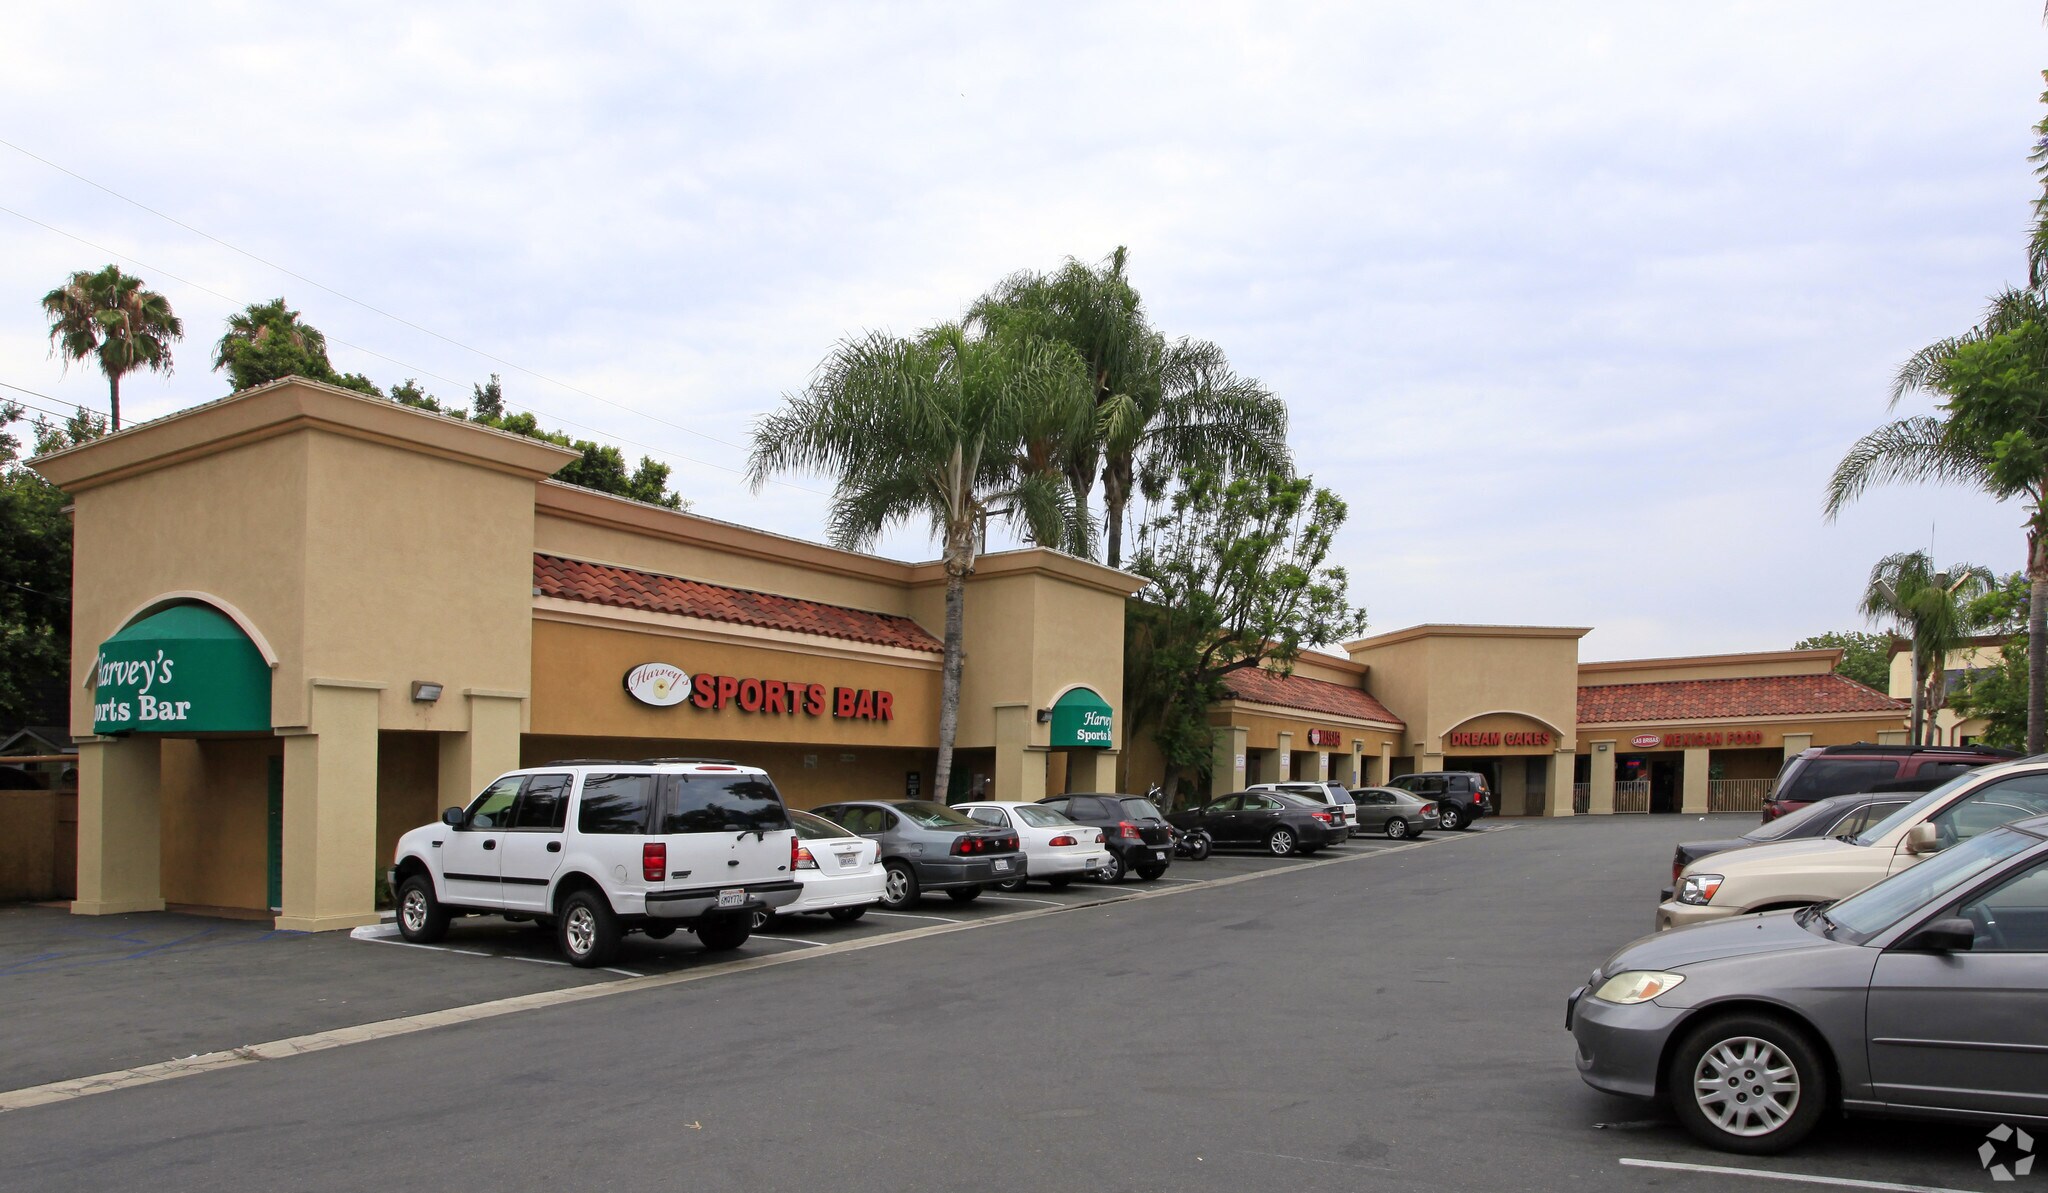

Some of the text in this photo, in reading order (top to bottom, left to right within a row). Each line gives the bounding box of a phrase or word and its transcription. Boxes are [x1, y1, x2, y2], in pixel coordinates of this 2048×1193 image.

[97, 650, 174, 694] Harvey's
[629, 664, 690, 691] Harvey's
[692, 673, 894, 720] SPORTS BAR
[94, 695, 191, 728] orts Bar
[1077, 729, 1107, 742] Sports
[1451, 732, 1550, 746] DREAM CAKES
[1664, 730, 1763, 747] MEXICAN FOOD
